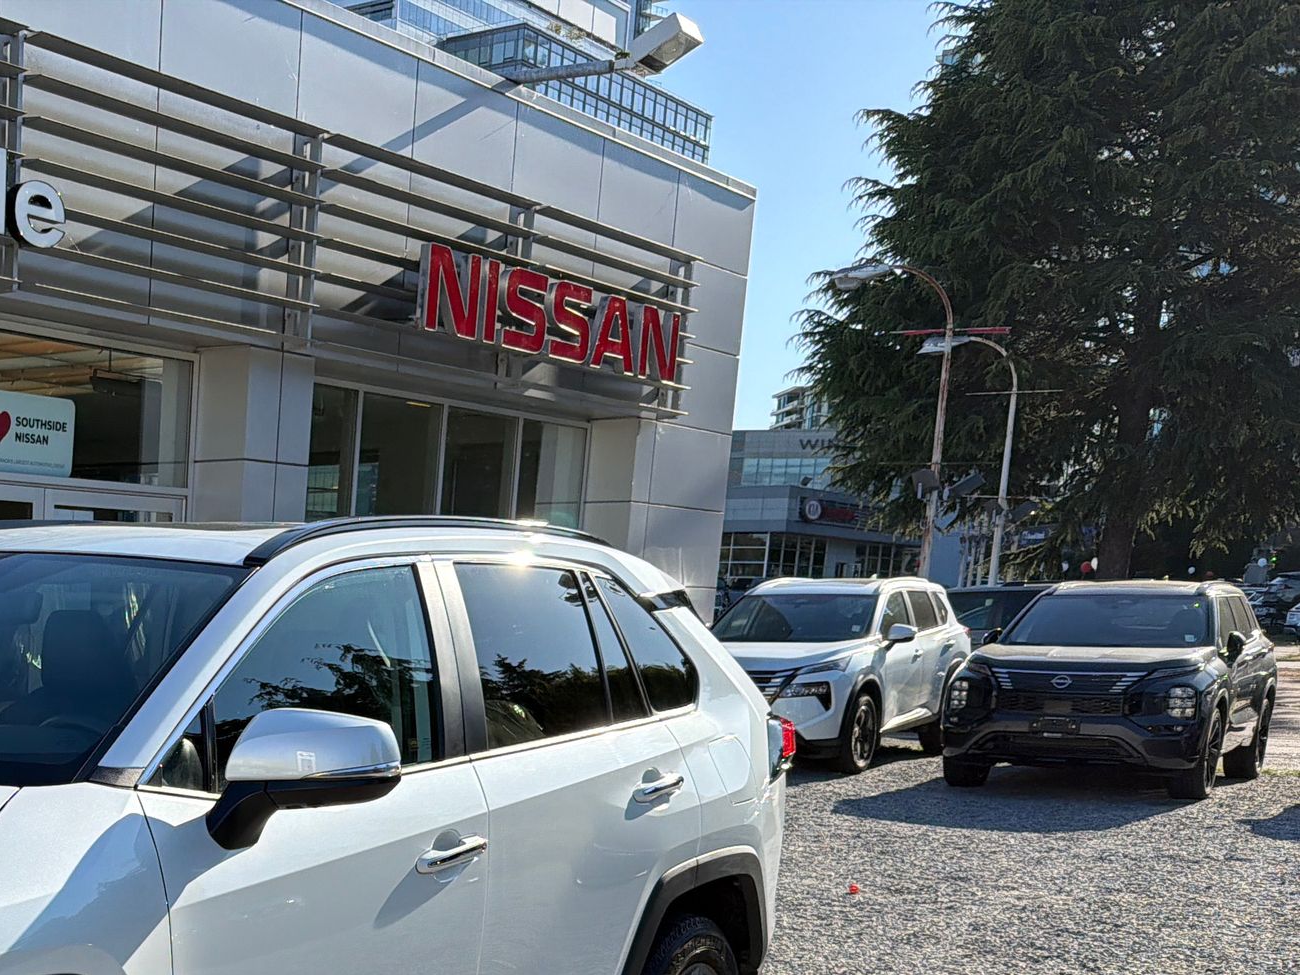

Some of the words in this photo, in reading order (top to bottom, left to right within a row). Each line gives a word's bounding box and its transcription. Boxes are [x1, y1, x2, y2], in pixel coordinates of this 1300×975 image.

[420, 243, 681, 384] NISSAN
[15, 416, 67, 432] SOUTHSIDE
[15, 432, 49, 445] NISSAN
